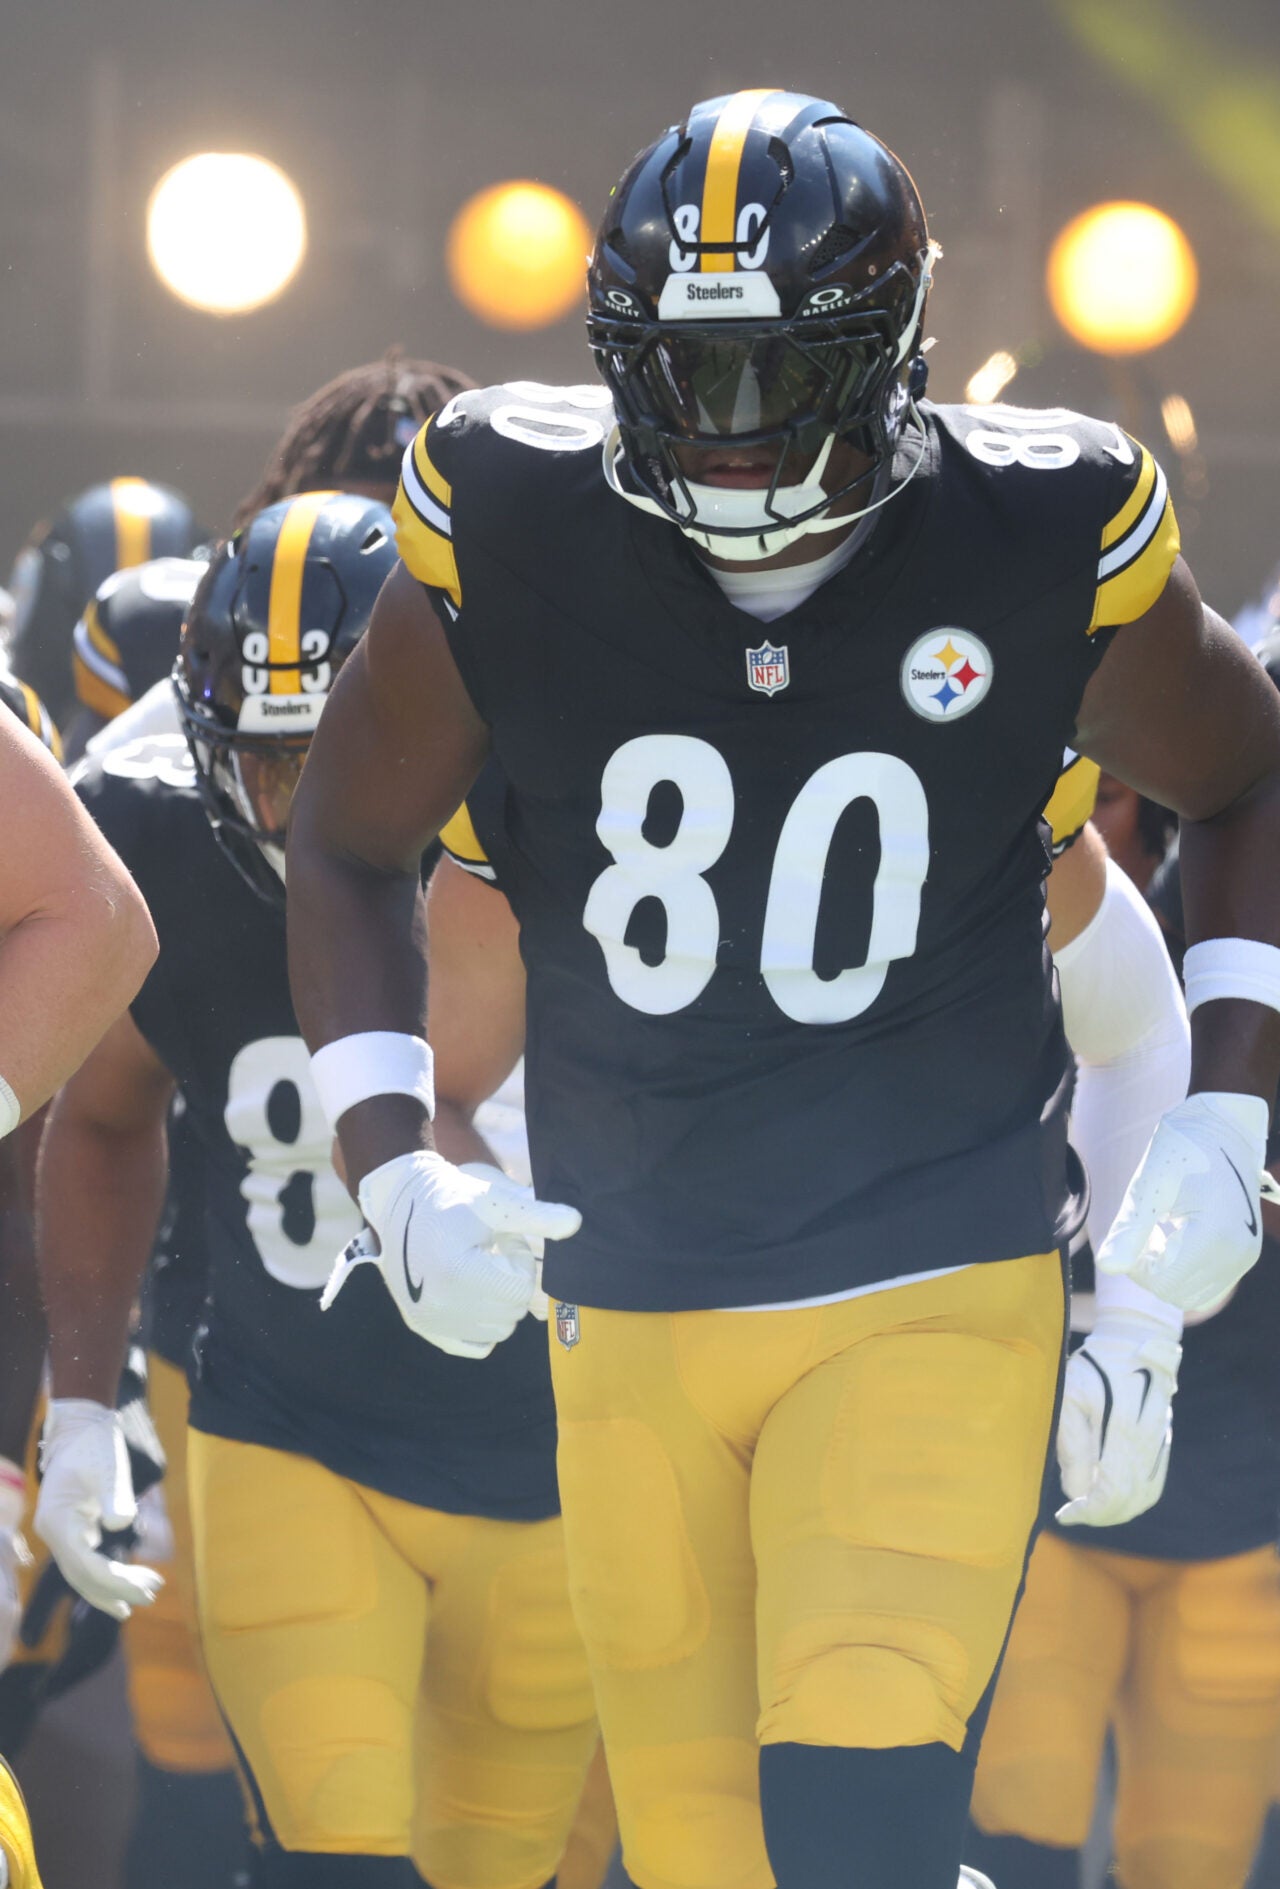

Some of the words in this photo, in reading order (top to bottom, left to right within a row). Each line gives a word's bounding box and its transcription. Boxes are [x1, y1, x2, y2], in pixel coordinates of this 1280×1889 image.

[668, 202, 770, 272] 80
[686, 282, 744, 301] Steelers
[604, 299, 640, 318] OAKLEY
[802, 296, 851, 317] OAKLEY
[241, 628, 331, 695] 83
[754, 665, 784, 687] NFL
[911, 668, 946, 681] Steelers
[582, 733, 930, 1025] 80
[224, 1035, 363, 1290] 8
